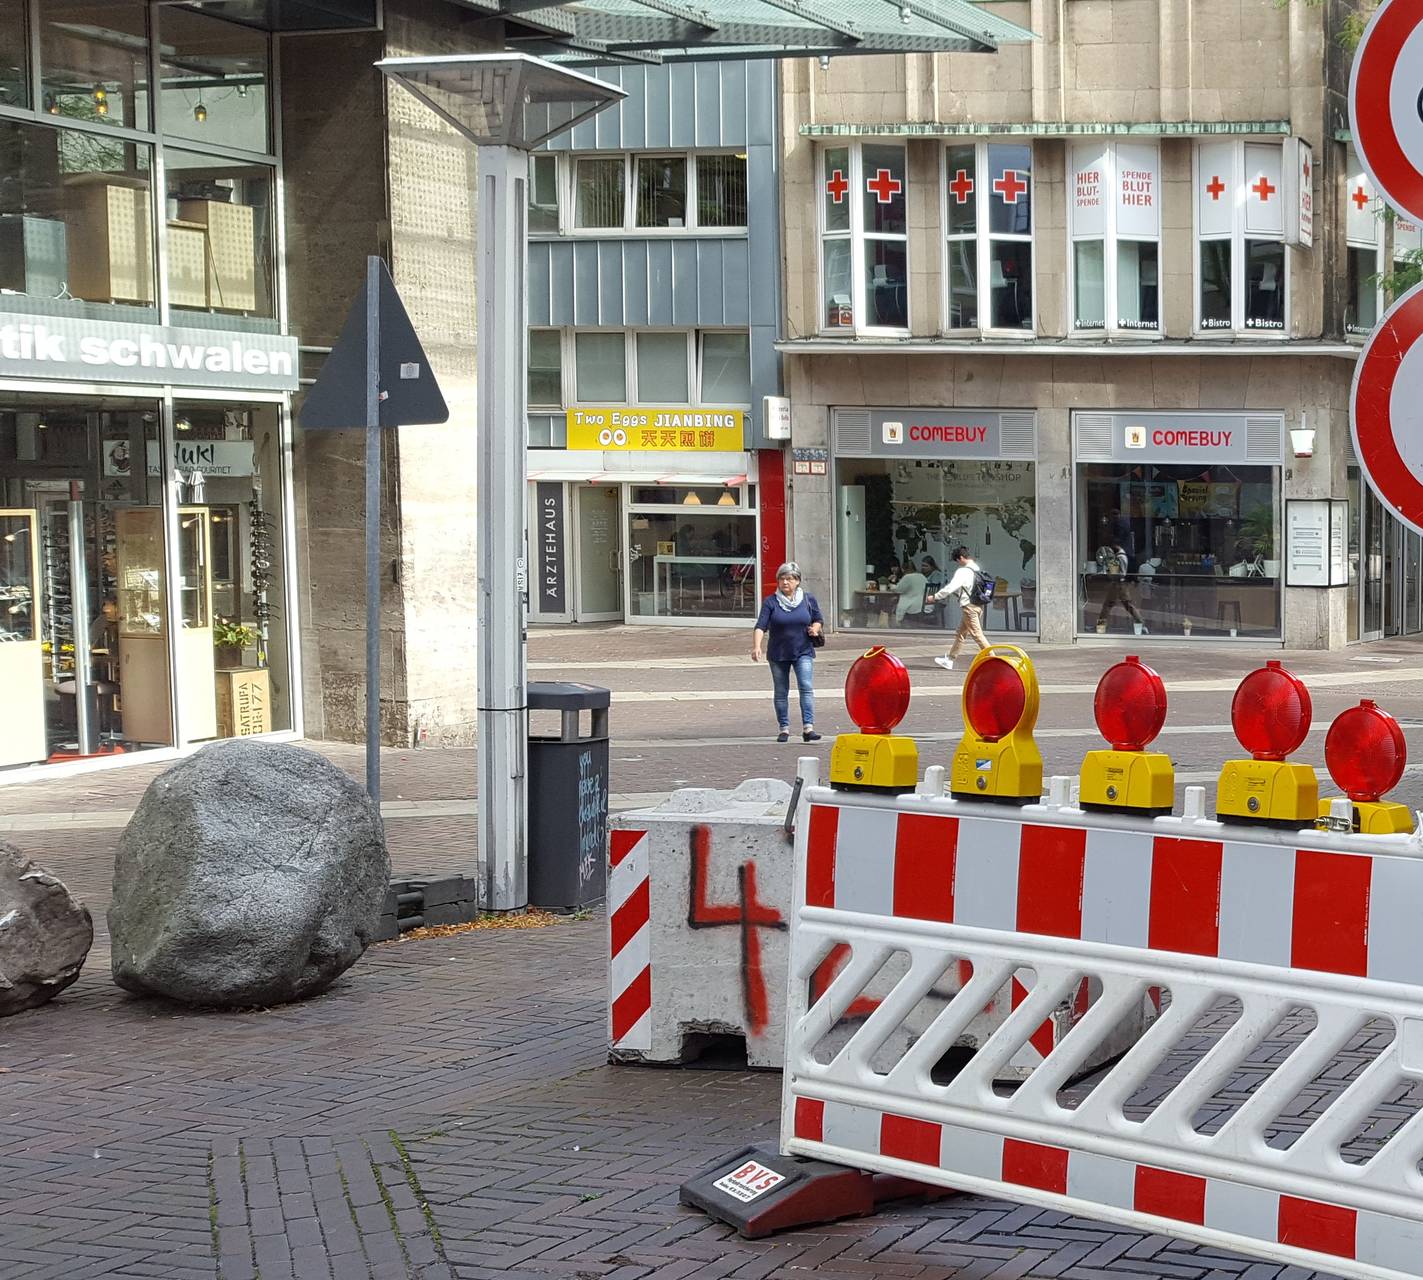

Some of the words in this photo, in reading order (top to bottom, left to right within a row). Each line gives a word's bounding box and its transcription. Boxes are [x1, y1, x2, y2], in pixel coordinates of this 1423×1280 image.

[1077, 171, 1100, 186] HIER
[1121, 171, 1153, 181] SPENDE
[1077, 186, 1100, 198] BLUT-
[1122, 181, 1153, 194] BLUT
[1077, 198, 1100, 207] SPENDE
[1122, 194, 1153, 207] HIER
[1081, 319, 1105, 329] Internet
[1126, 319, 1159, 330] Internet
[1208, 319, 1231, 330] Bistro
[1255, 319, 1283, 330] Bistro
[80, 335, 292, 376] schwalen
[574, 411, 604, 426] Two
[611, 411, 647, 428] Eggs
[654, 413, 735, 428] JIANBING
[908, 426, 987, 441] COMEBUY
[1152, 430, 1233, 446] COMEBUY
[546, 497, 556, 597] ÄRZTEHAUS
[238, 683, 250, 736] SATRUPA
[688, 825, 787, 1035] 4
[735, 1164, 778, 1190] BVS
